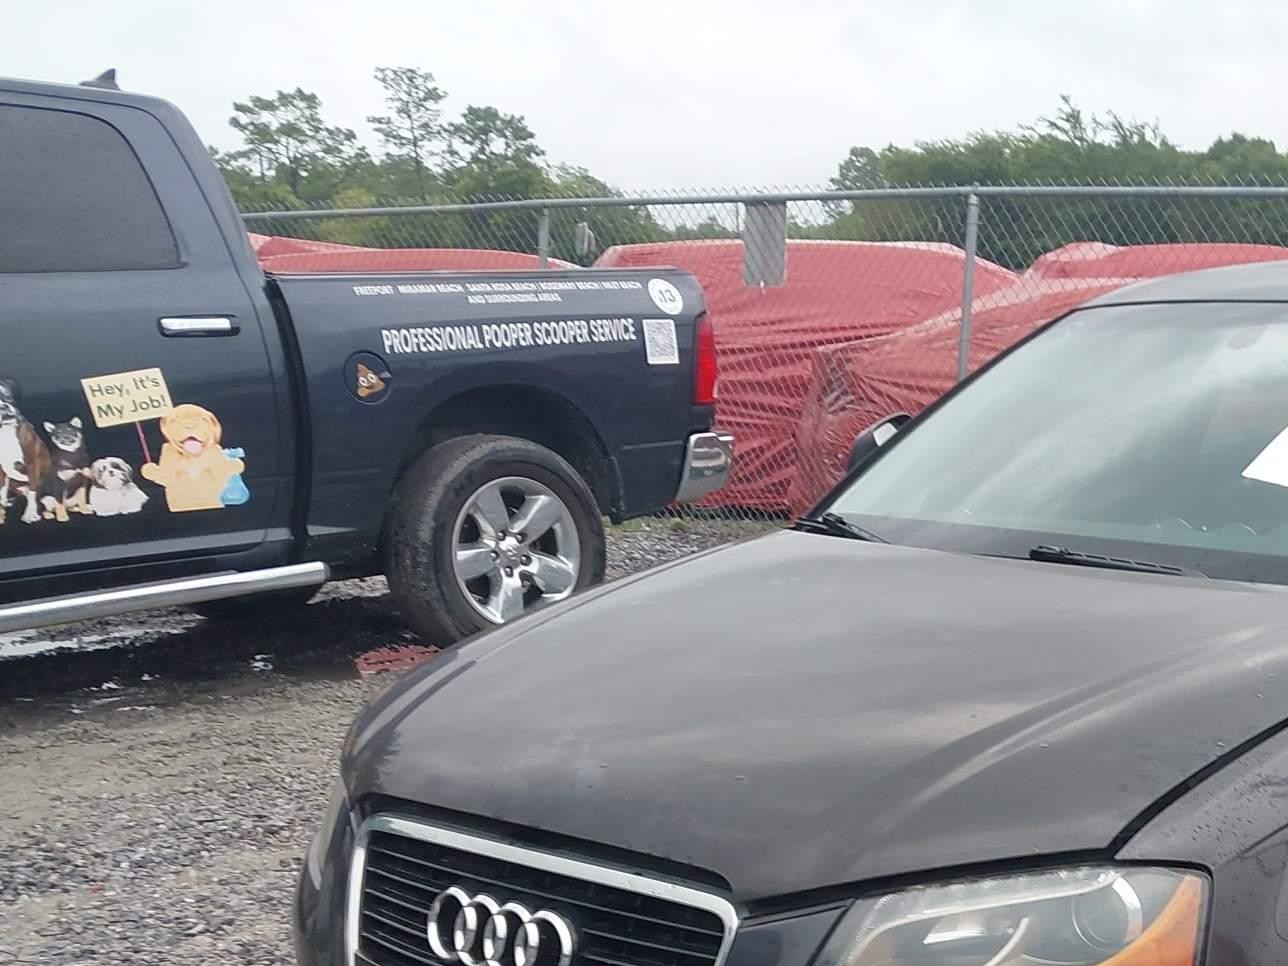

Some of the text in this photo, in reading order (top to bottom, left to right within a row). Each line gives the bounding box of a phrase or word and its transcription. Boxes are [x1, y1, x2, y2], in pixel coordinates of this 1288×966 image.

[436, 283, 464, 293] BEACH
[466, 283, 491, 292] SANTA
[512, 282, 537, 291] BEACH
[577, 281, 599, 290] BEACH
[620, 280, 643, 289] BEACH
[467, 292, 562, 304] AND SURROUNDING AREAS
[381, 318, 637, 354] PROFESSIONAL POOPER SCOOPER SERVICE
[89, 375, 160, 398] Hey, It's
[96, 394, 168, 419] My Job!
